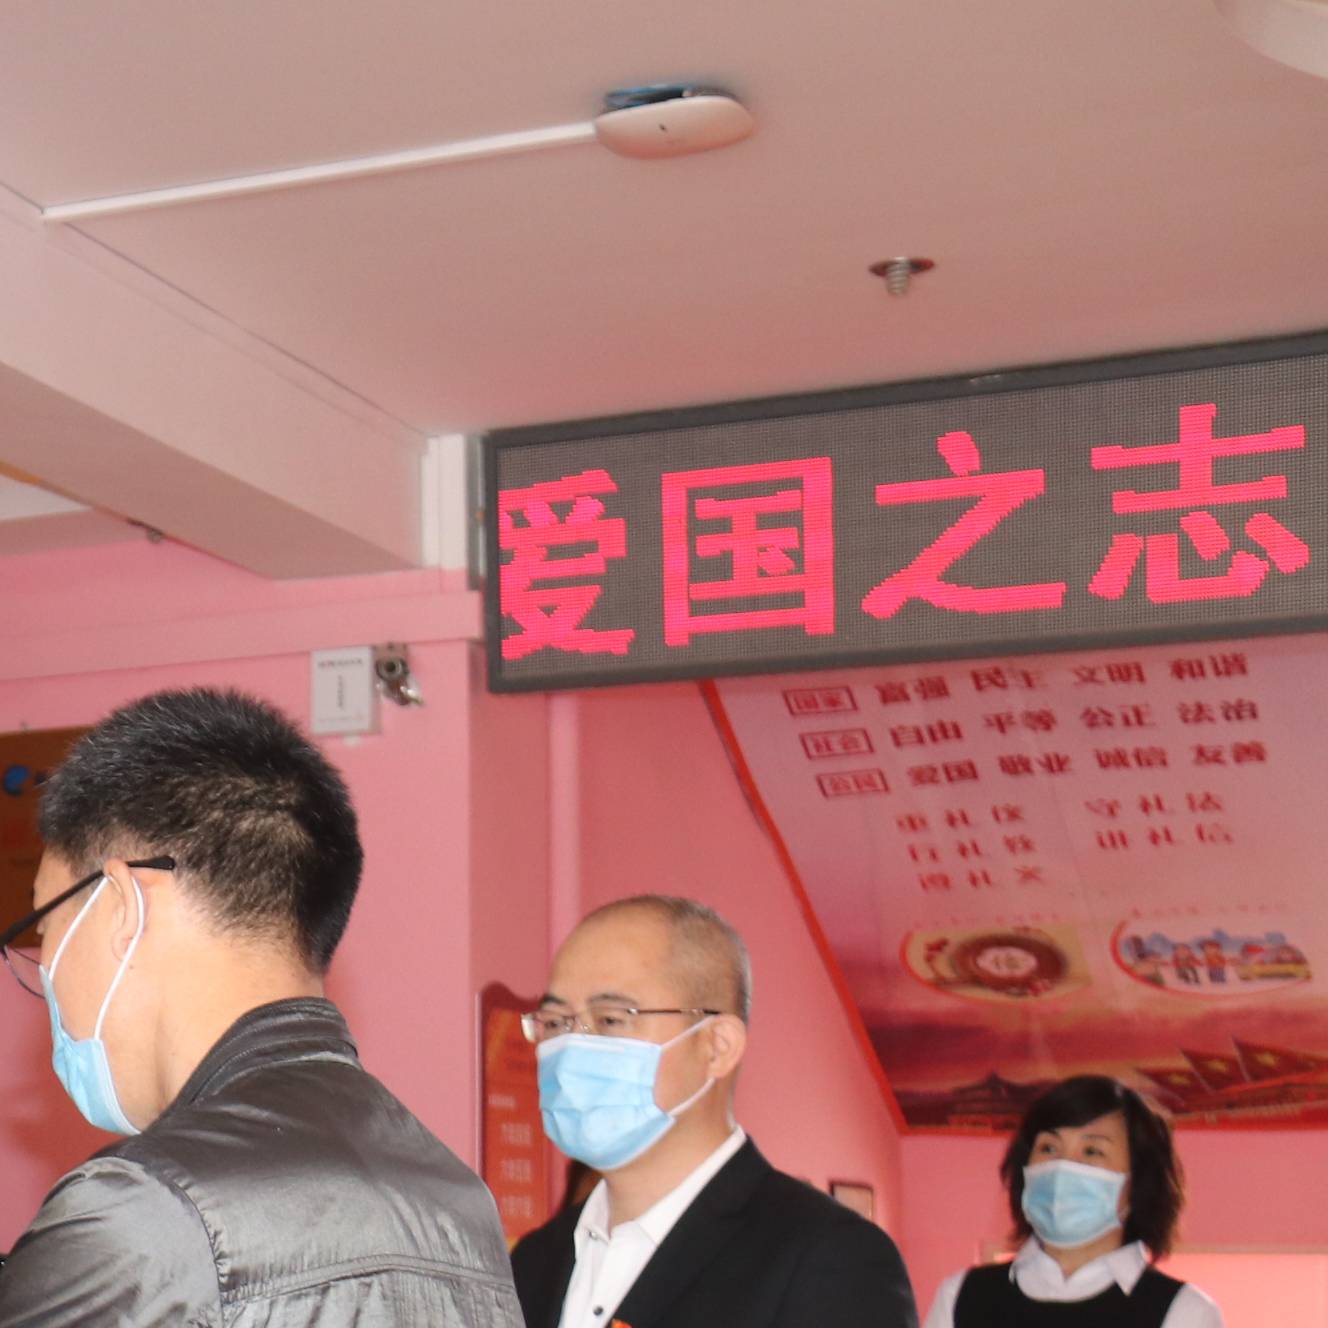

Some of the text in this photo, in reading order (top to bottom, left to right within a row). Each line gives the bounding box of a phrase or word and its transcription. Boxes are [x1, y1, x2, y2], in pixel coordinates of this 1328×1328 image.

[497, 402, 1310, 660] 爱国之志
[793, 653, 1248, 711] 国家 富强 民主 文明 和谐
[812, 698, 1259, 754] 社会 自由 平等 公正 法治
[829, 741, 1267, 794] 公民 爱国 敬业 诚信 友善
